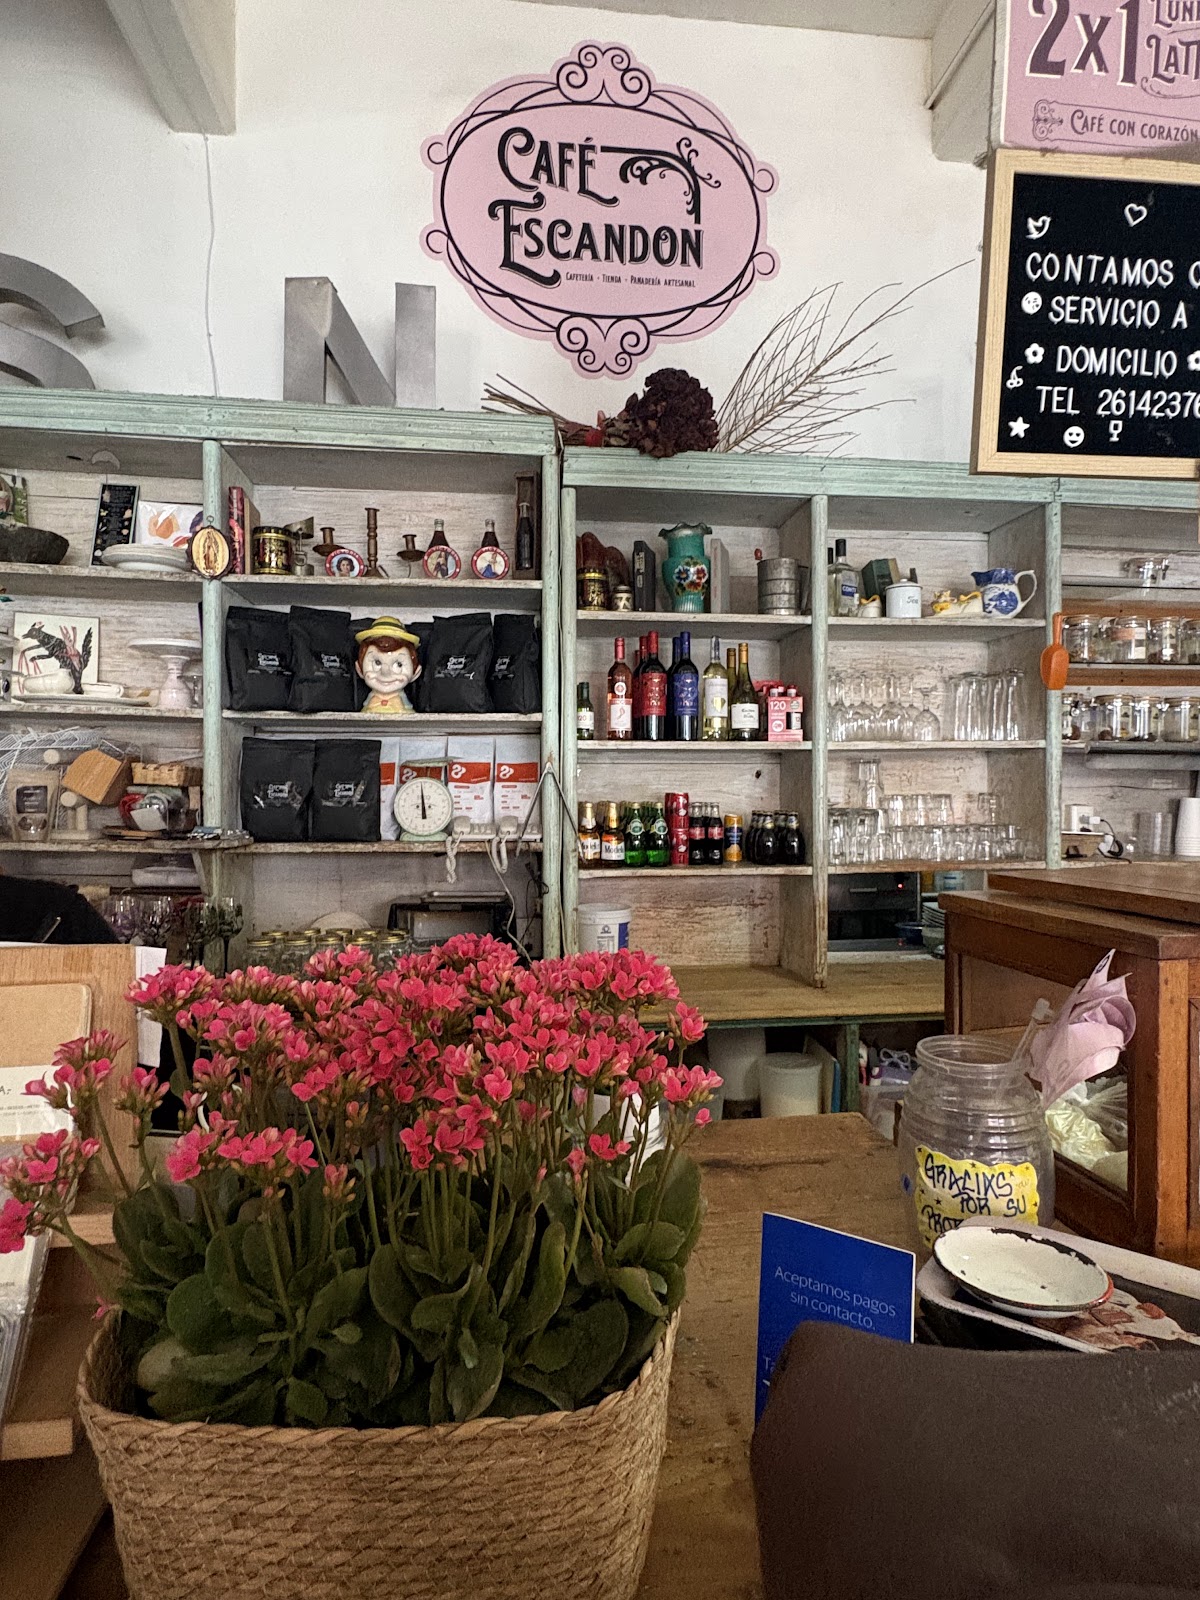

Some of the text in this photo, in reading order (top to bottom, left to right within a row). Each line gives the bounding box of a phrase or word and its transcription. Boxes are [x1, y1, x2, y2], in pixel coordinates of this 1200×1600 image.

[1070, 109, 1104, 135] CAFÉ
[1109, 118, 1136, 136] CON
[498, 126, 620, 208] CAFÉ
[487, 192, 703, 288] ESCANDON
[602, 273, 622, 284] TIENDA
[663, 278, 696, 288] ARTESANAL
[1025, 252, 1174, 289] CONTAMOS
[1048, 295, 1188, 329] SERVICIO A
[1056, 345, 1178, 379] DOMICILIO
[1036, 386, 1080, 415] TEL
[770, 701, 787, 710] 120
[924, 1153, 1012, 1199] GRACIAS
[958, 1192, 1026, 1217] POR SU
[774, 1266, 896, 1317] Aceptamos pagos
[790, 1291, 876, 1331] sin contacto.
